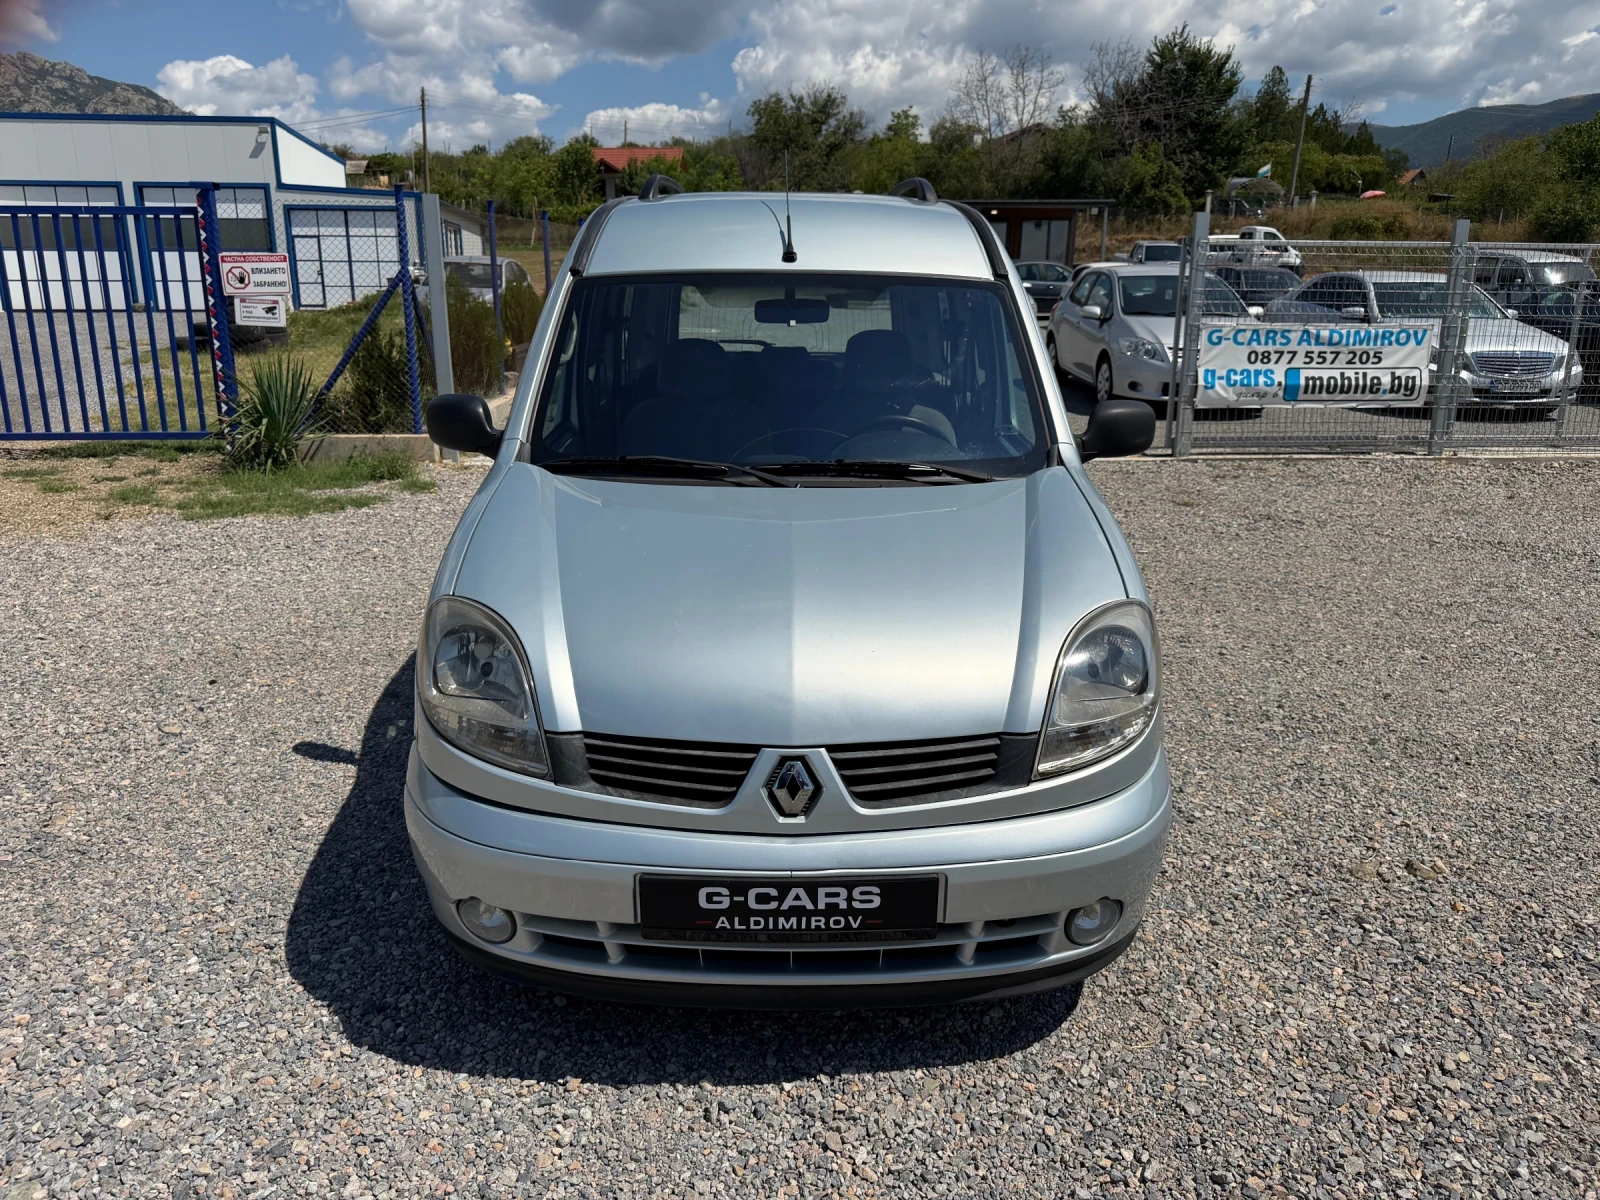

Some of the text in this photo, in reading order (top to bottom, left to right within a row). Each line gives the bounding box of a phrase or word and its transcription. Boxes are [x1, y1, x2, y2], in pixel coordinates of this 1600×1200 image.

[251, 267, 286, 275] ВЛИЗАНЕТО
[1207, 328, 1428, 347] G-CARS ALDIMIROV
[1247, 350, 1383, 365] 0877 557 205
[1303, 371, 1417, 397] mobile.bg
[698, 886, 881, 910] G-CARS
[714, 915, 863, 930] ALDIMIROV
